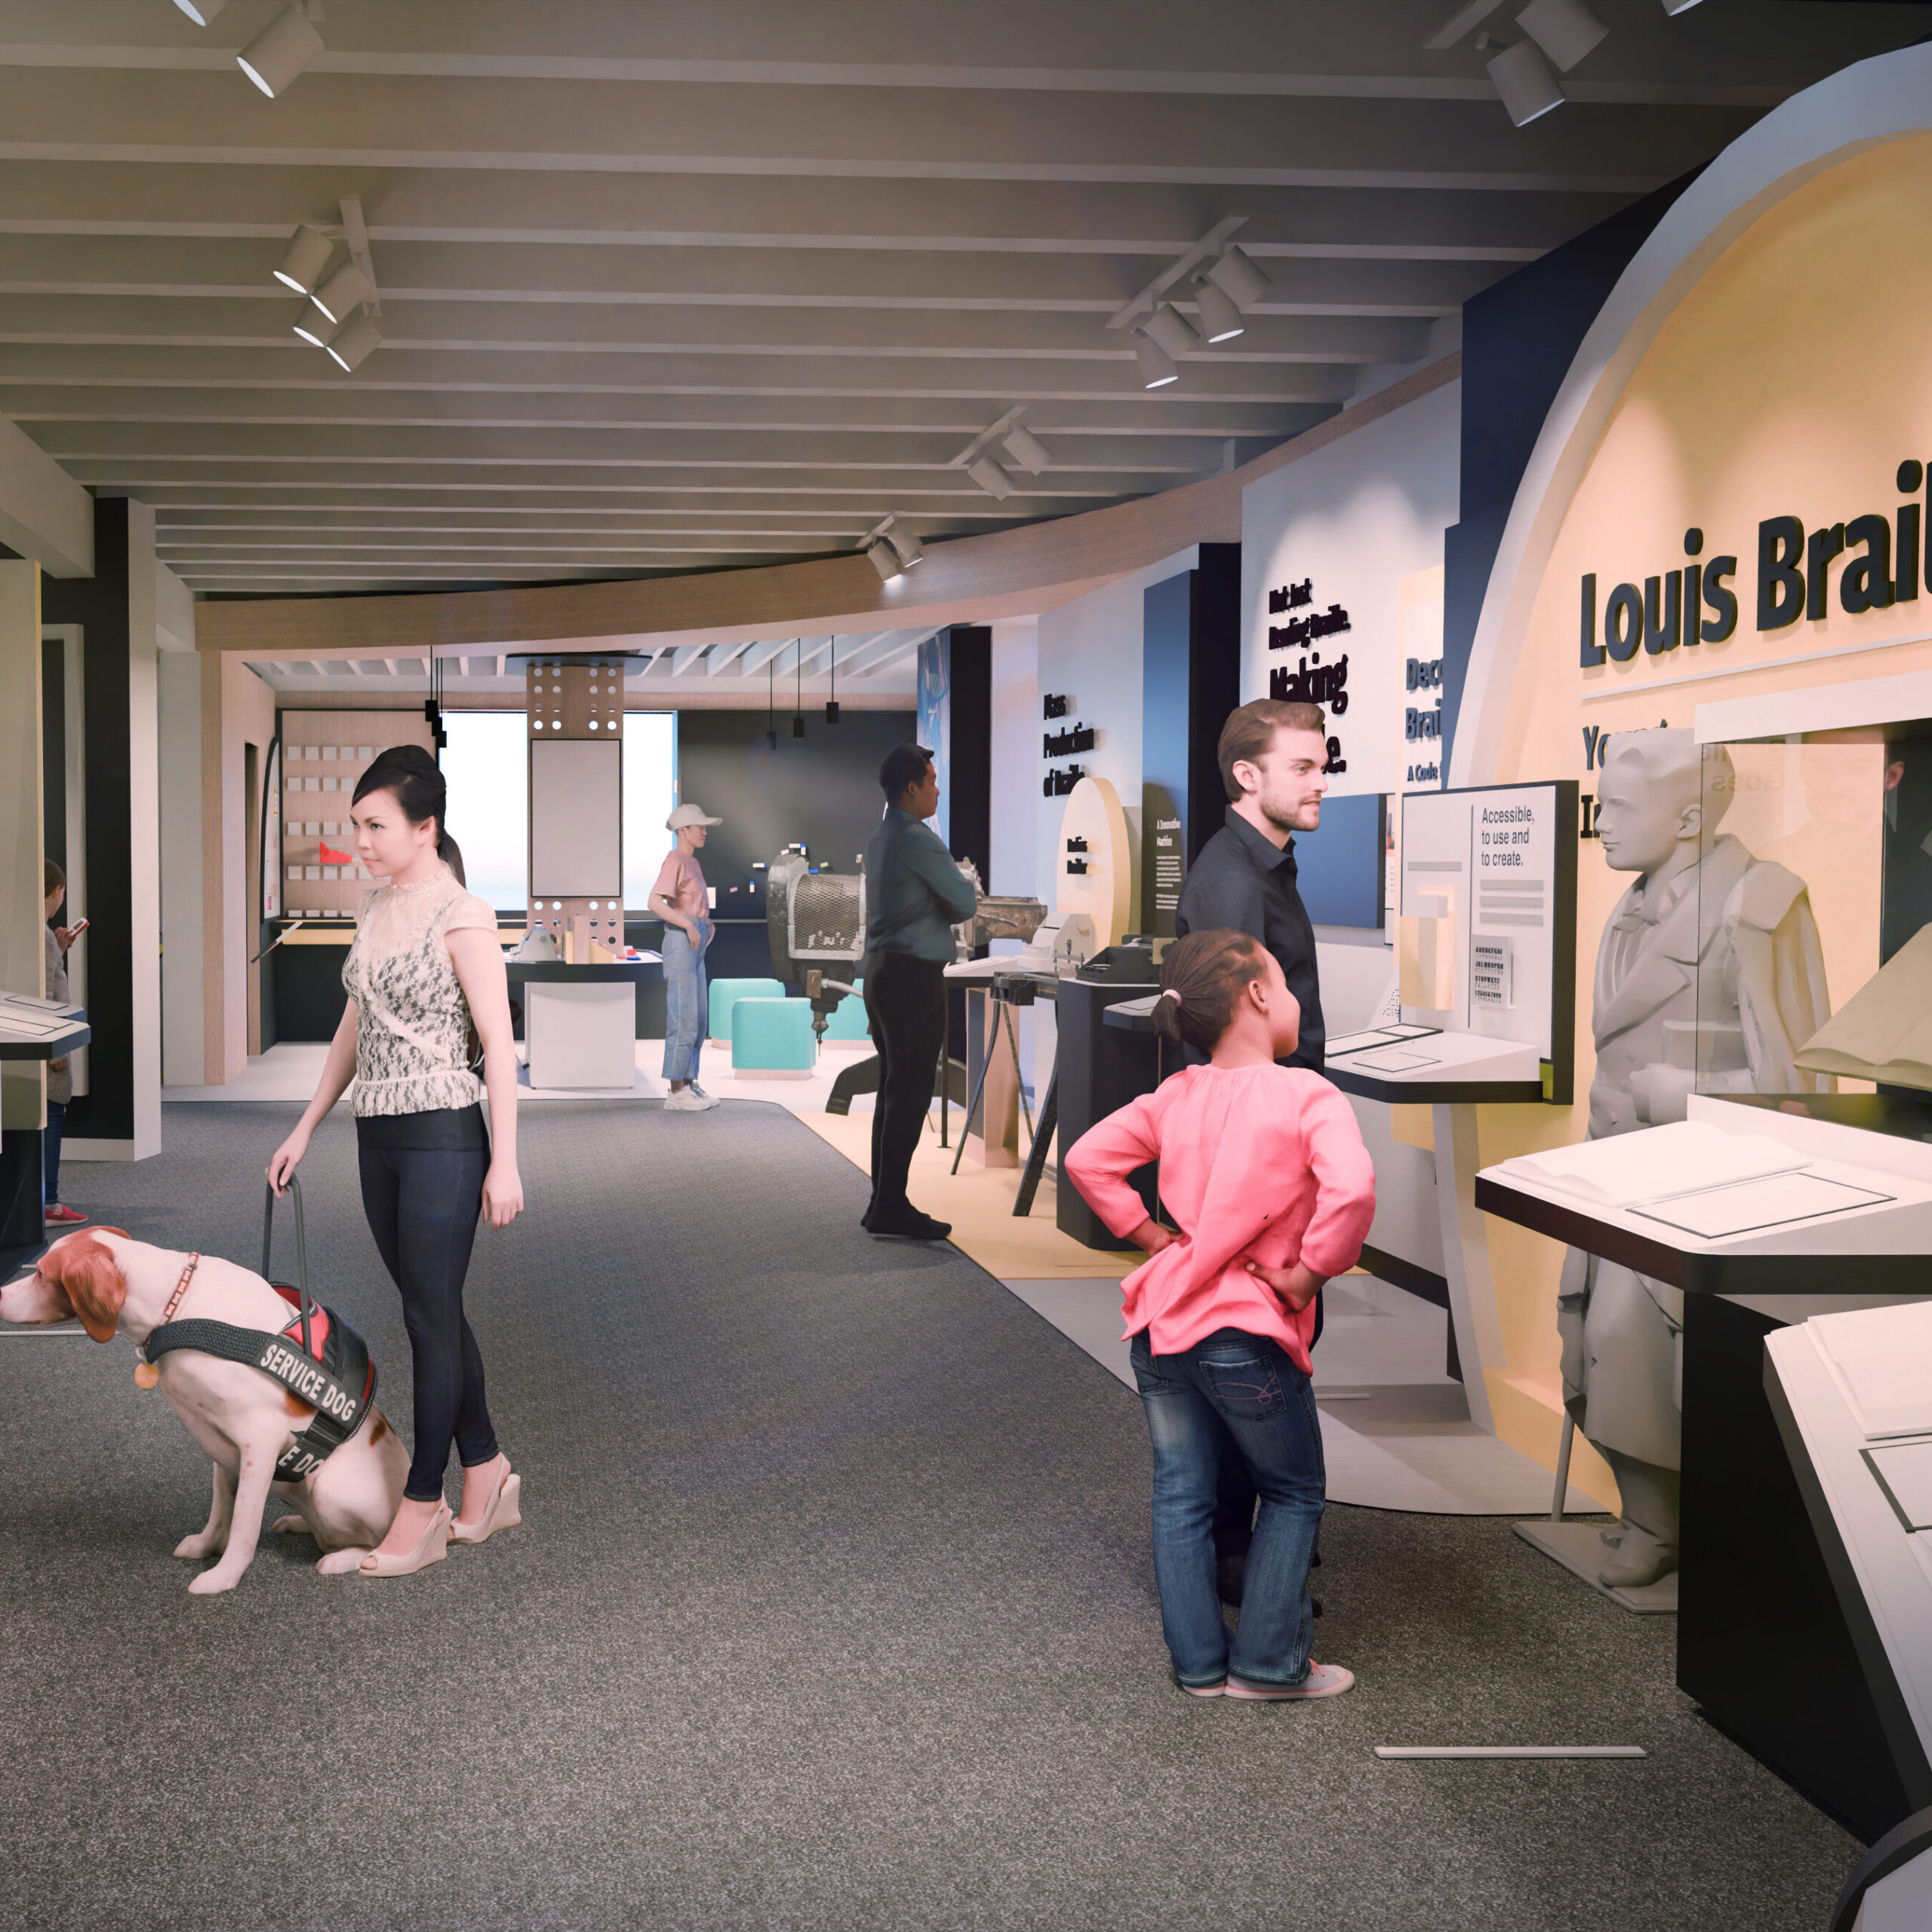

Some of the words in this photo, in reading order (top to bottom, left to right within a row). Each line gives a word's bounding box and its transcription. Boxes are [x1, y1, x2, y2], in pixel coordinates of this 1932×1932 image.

[1580, 528, 1738, 669] Louis
[1269, 652, 1349, 715] Making
[1407, 765, 1414, 782] A
[1415, 761, 1438, 782] Code
[1481, 805, 1534, 824] Accessible,
[1481, 829, 1491, 844] to
[1493, 832, 1509, 844] use
[1512, 827, 1529, 844] and
[1481, 851, 1490, 866] to
[1492, 851, 1523, 866] create.
[260, 1344, 326, 1401] SERVICE
[321, 1383, 357, 1422] DOG
